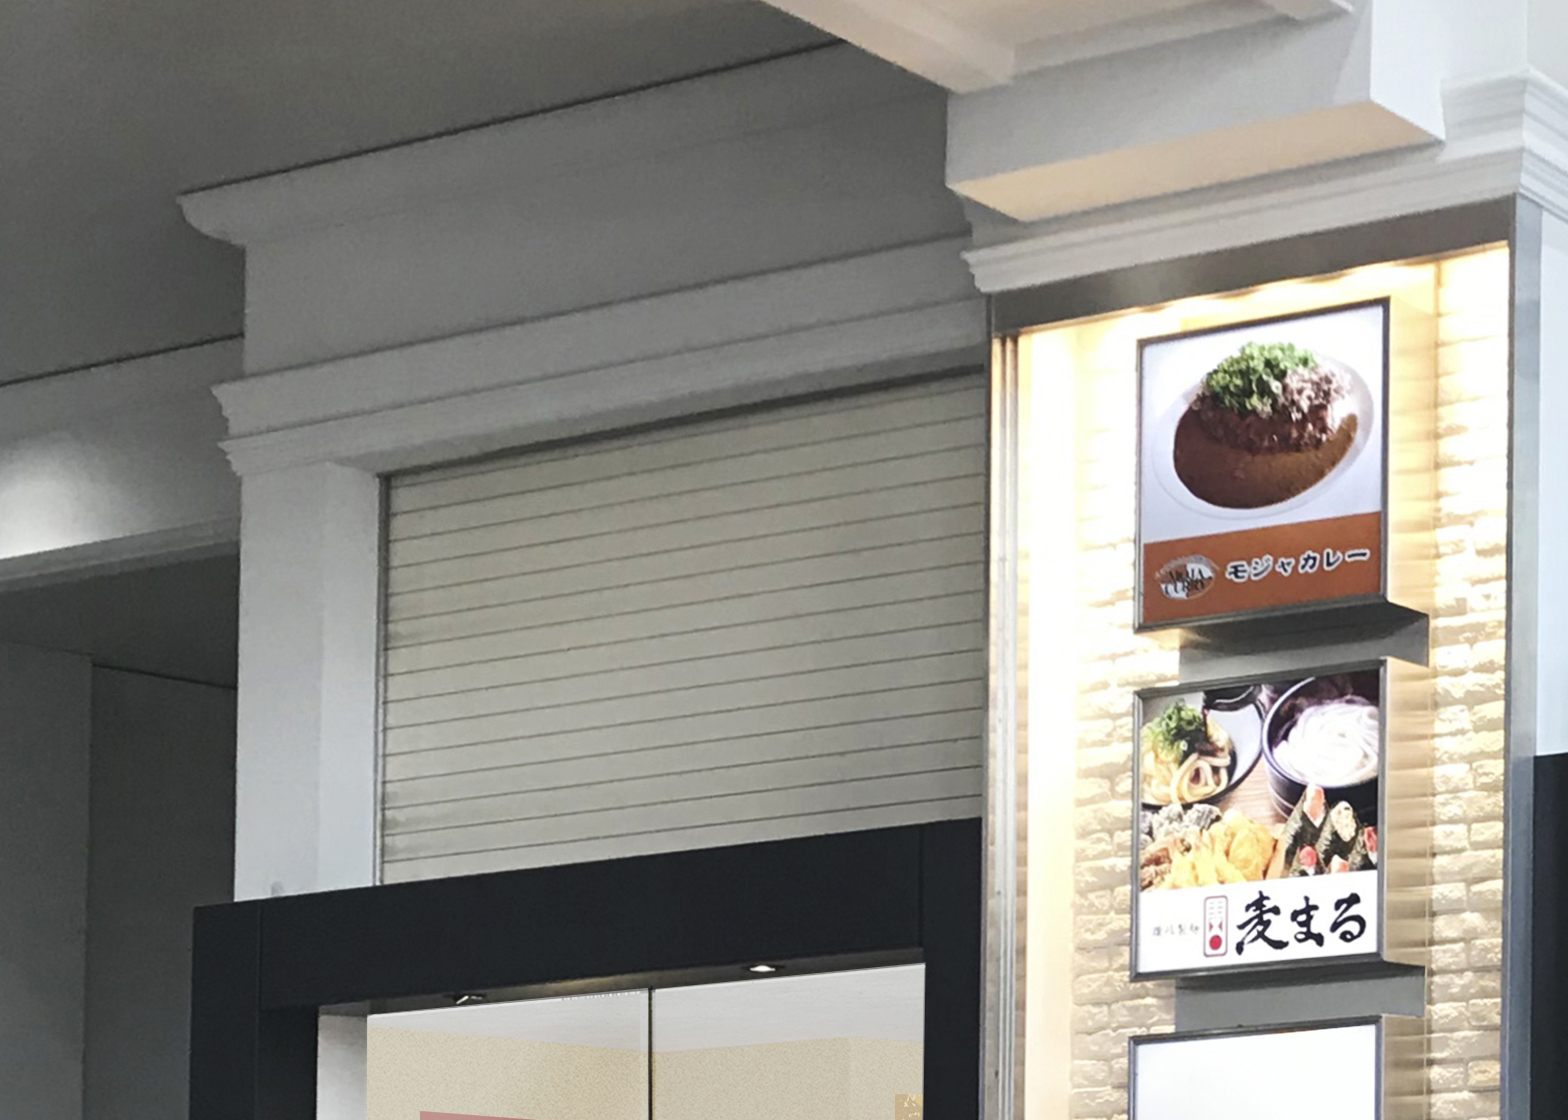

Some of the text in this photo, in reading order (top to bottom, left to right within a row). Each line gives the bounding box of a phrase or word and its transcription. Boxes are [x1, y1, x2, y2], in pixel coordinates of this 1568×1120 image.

[1226, 549, 1370, 582] モジャカレー
[1235, 890, 1367, 956] 麦まる
